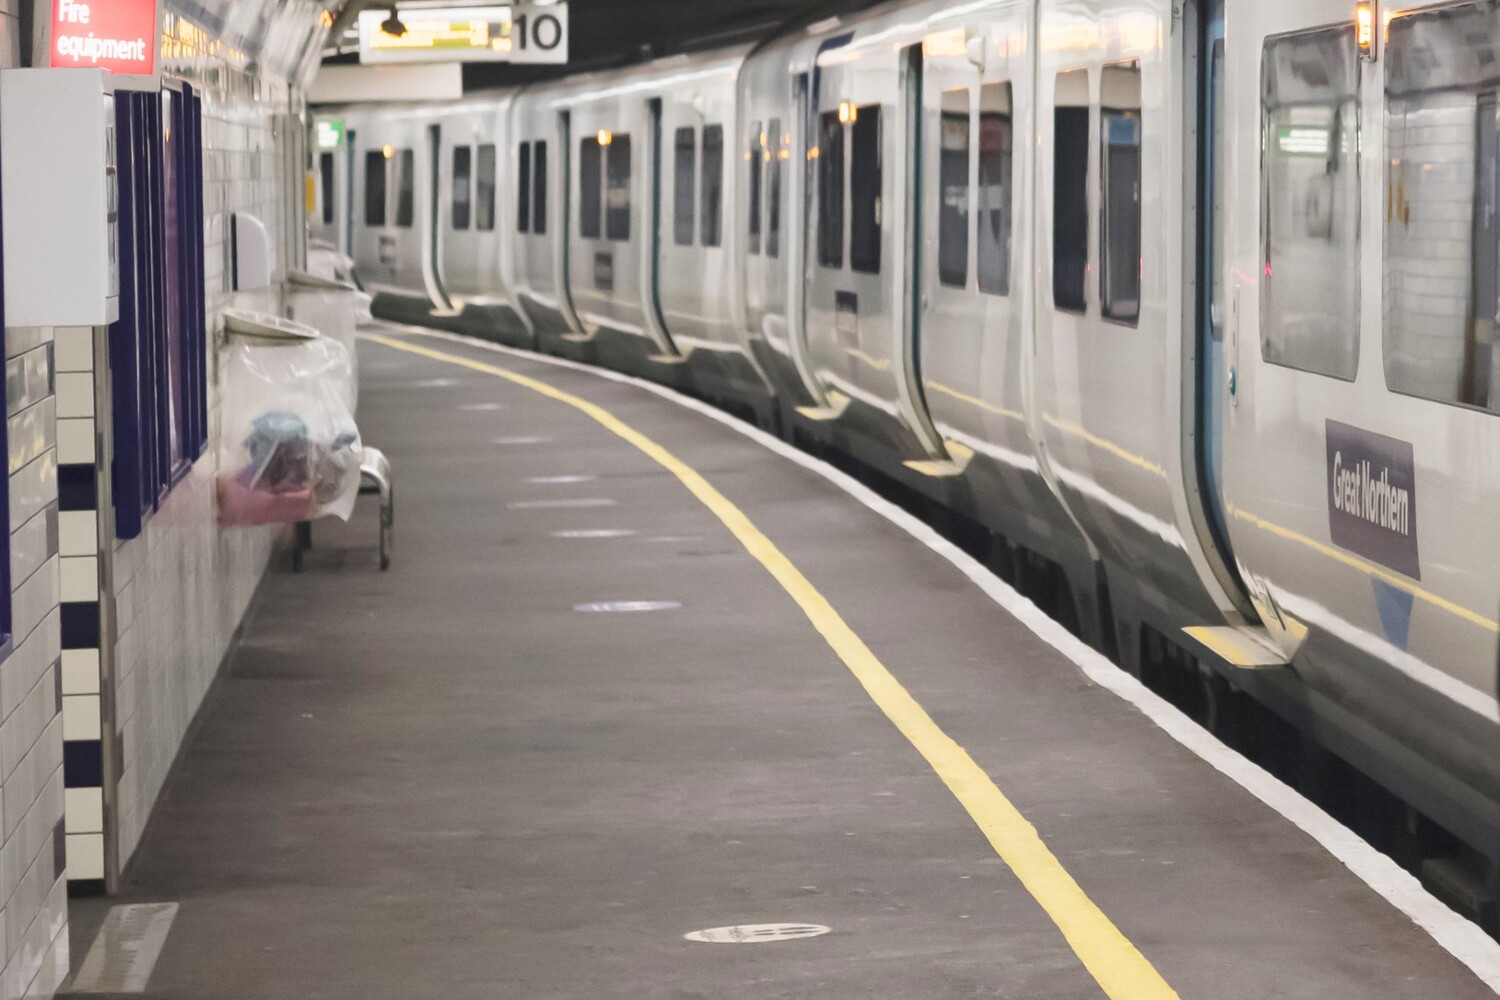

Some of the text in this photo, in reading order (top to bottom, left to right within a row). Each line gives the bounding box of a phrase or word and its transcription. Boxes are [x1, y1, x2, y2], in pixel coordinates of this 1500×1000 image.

[57, 31, 146, 62] equipment
[515, 13, 562, 51] 10
[1333, 450, 1409, 536] Great Northern
